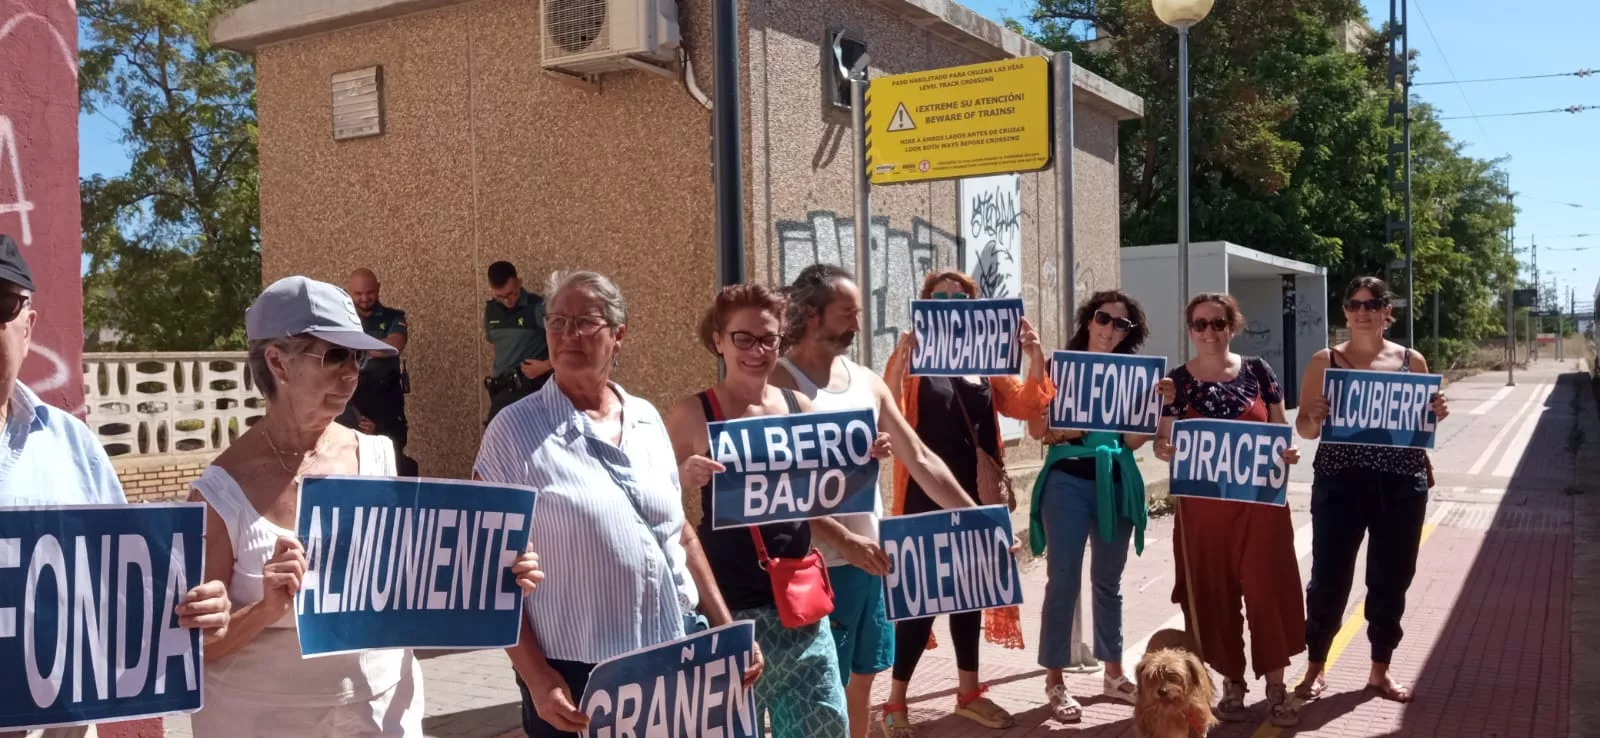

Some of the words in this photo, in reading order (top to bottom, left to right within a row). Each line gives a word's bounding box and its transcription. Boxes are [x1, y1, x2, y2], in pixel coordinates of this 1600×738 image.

[909, 74, 947, 84] HABILITADO
[967, 68, 992, 76] CRUZAR
[916, 101, 958, 112] ¡EXTREME
[960, 100, 972, 108] SU
[974, 92, 1024, 106] ATENCIÓN!
[939, 80, 959, 88] TRACK
[960, 76, 994, 86] CROSSING
[925, 112, 962, 124] BEWARE
[964, 111, 976, 120] OF
[978, 107, 1015, 118] TRAINS!
[967, 130, 988, 138] ANTES
[998, 126, 1024, 135] CRUZAR
[986, 136, 1020, 144] CROSSING
[912, 307, 1022, 369] SANGARREN
[1052, 359, 1162, 428] VALFONDA
[1324, 378, 1438, 433] ALCUBIERRE
[716, 419, 872, 473] ALBERO
[1173, 429, 1287, 489] PIRACES
[743, 468, 848, 518] BAJO
[297, 504, 527, 614] ALMUNIENTE
[884, 512, 1016, 618] POLEÑINO
[582, 633, 753, 738] GRAÑÉN
